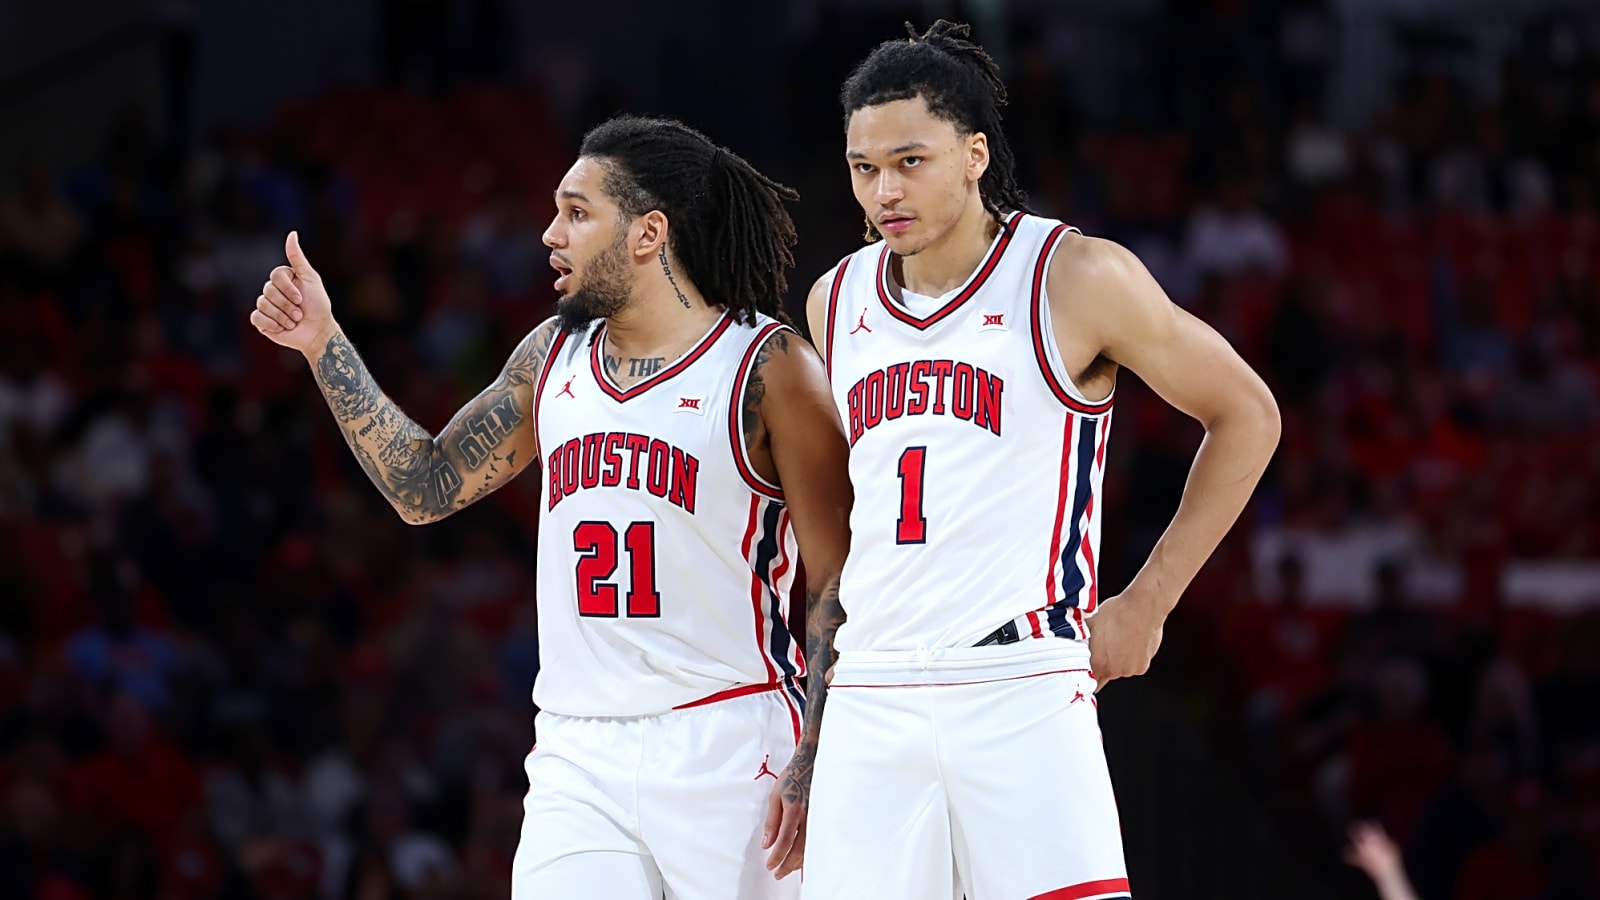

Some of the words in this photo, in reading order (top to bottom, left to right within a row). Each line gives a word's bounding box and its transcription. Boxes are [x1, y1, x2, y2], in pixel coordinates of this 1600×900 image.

[628, 356, 666, 377] THE
[847, 359, 1004, 449] HOUSTON
[359, 416, 377, 437] pass
[549, 432, 699, 516] HOUSTON
[896, 445, 927, 545] 1
[573, 520, 660, 618] 21
